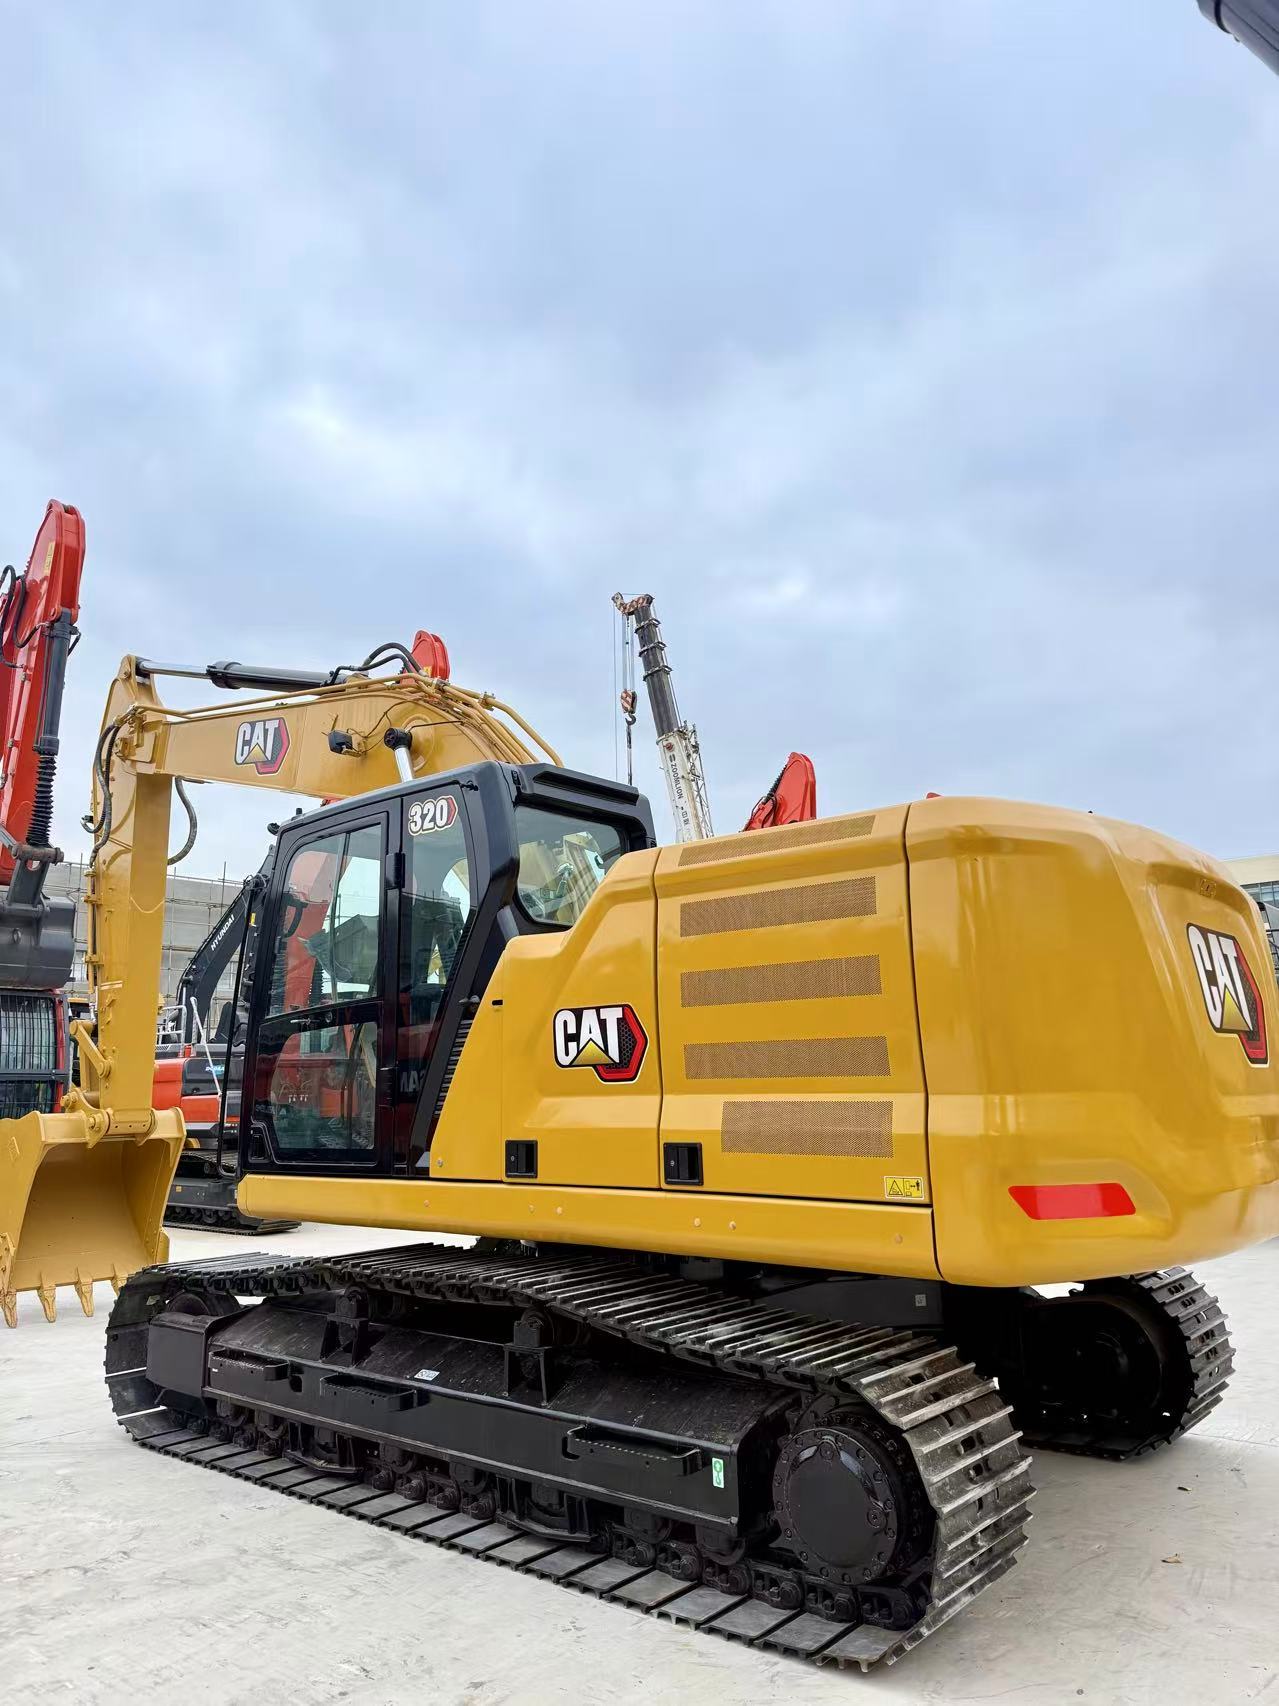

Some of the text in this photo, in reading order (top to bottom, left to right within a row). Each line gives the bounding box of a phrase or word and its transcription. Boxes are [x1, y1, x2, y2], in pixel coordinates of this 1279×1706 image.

[236, 719, 279, 763] CAT
[671, 762, 684, 799] ZOOMLION
[410, 799, 448, 832] 320
[210, 914, 235, 951] HYUNDAI
[1188, 925, 1253, 1031] CAT
[555, 1007, 622, 1066] CAT
